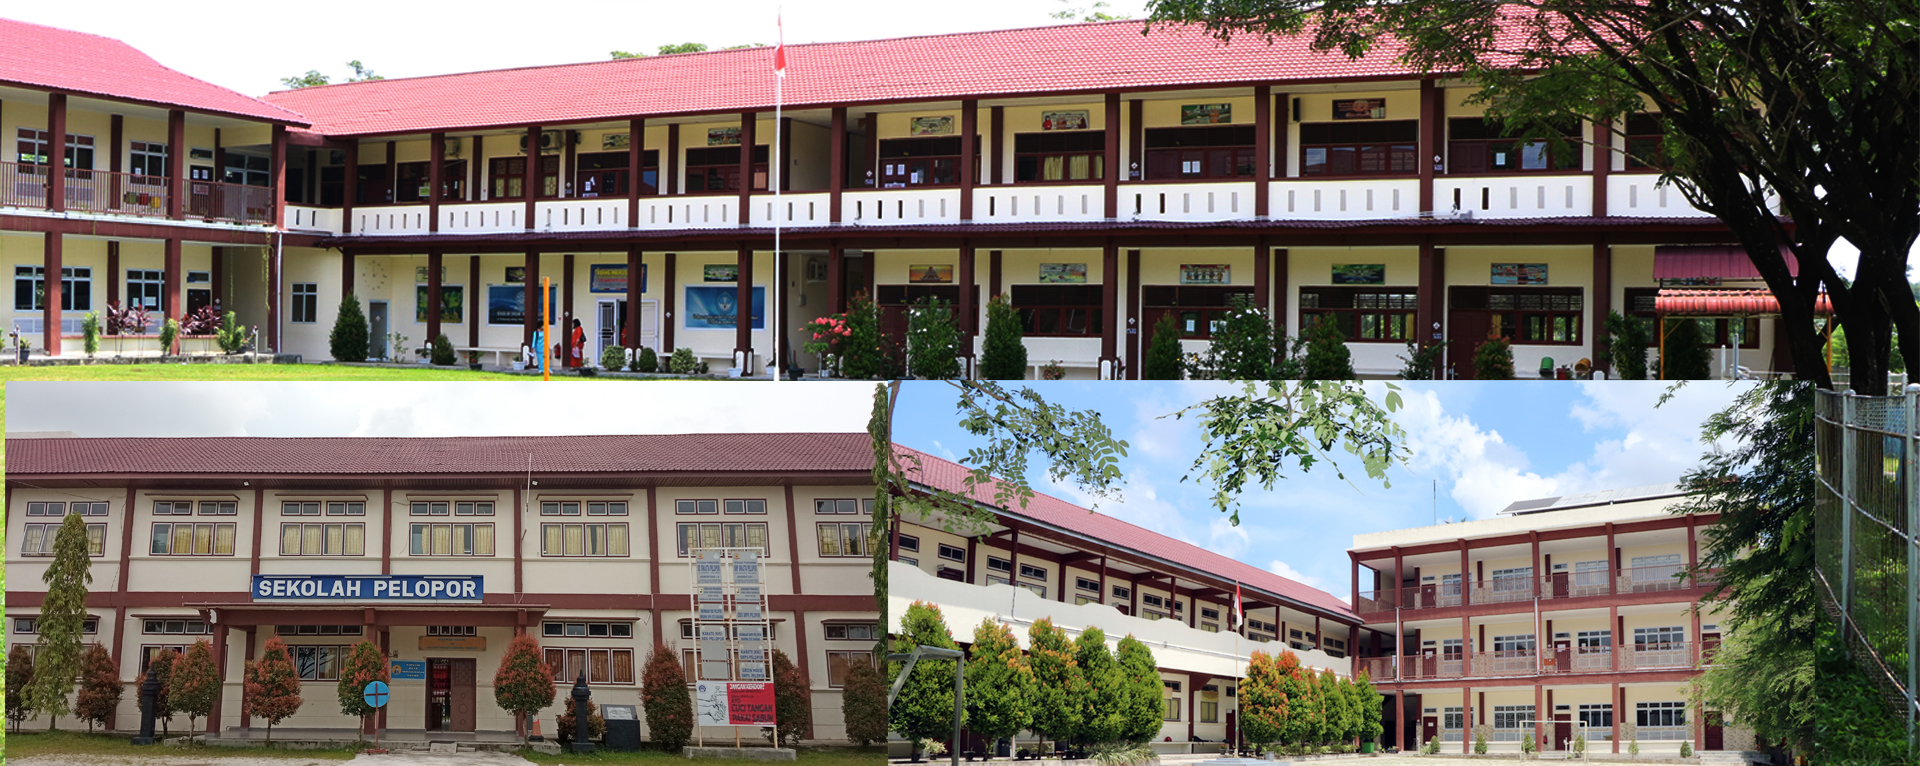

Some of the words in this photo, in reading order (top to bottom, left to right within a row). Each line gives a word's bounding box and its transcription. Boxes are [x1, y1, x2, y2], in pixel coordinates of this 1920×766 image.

[258, 580, 361, 597] SEKOLAH
[373, 580, 477, 598] PELOPOR
[732, 704, 746, 712] CUCI
[747, 704, 772, 712] TANGAN
[752, 714, 774, 722] SABUN
